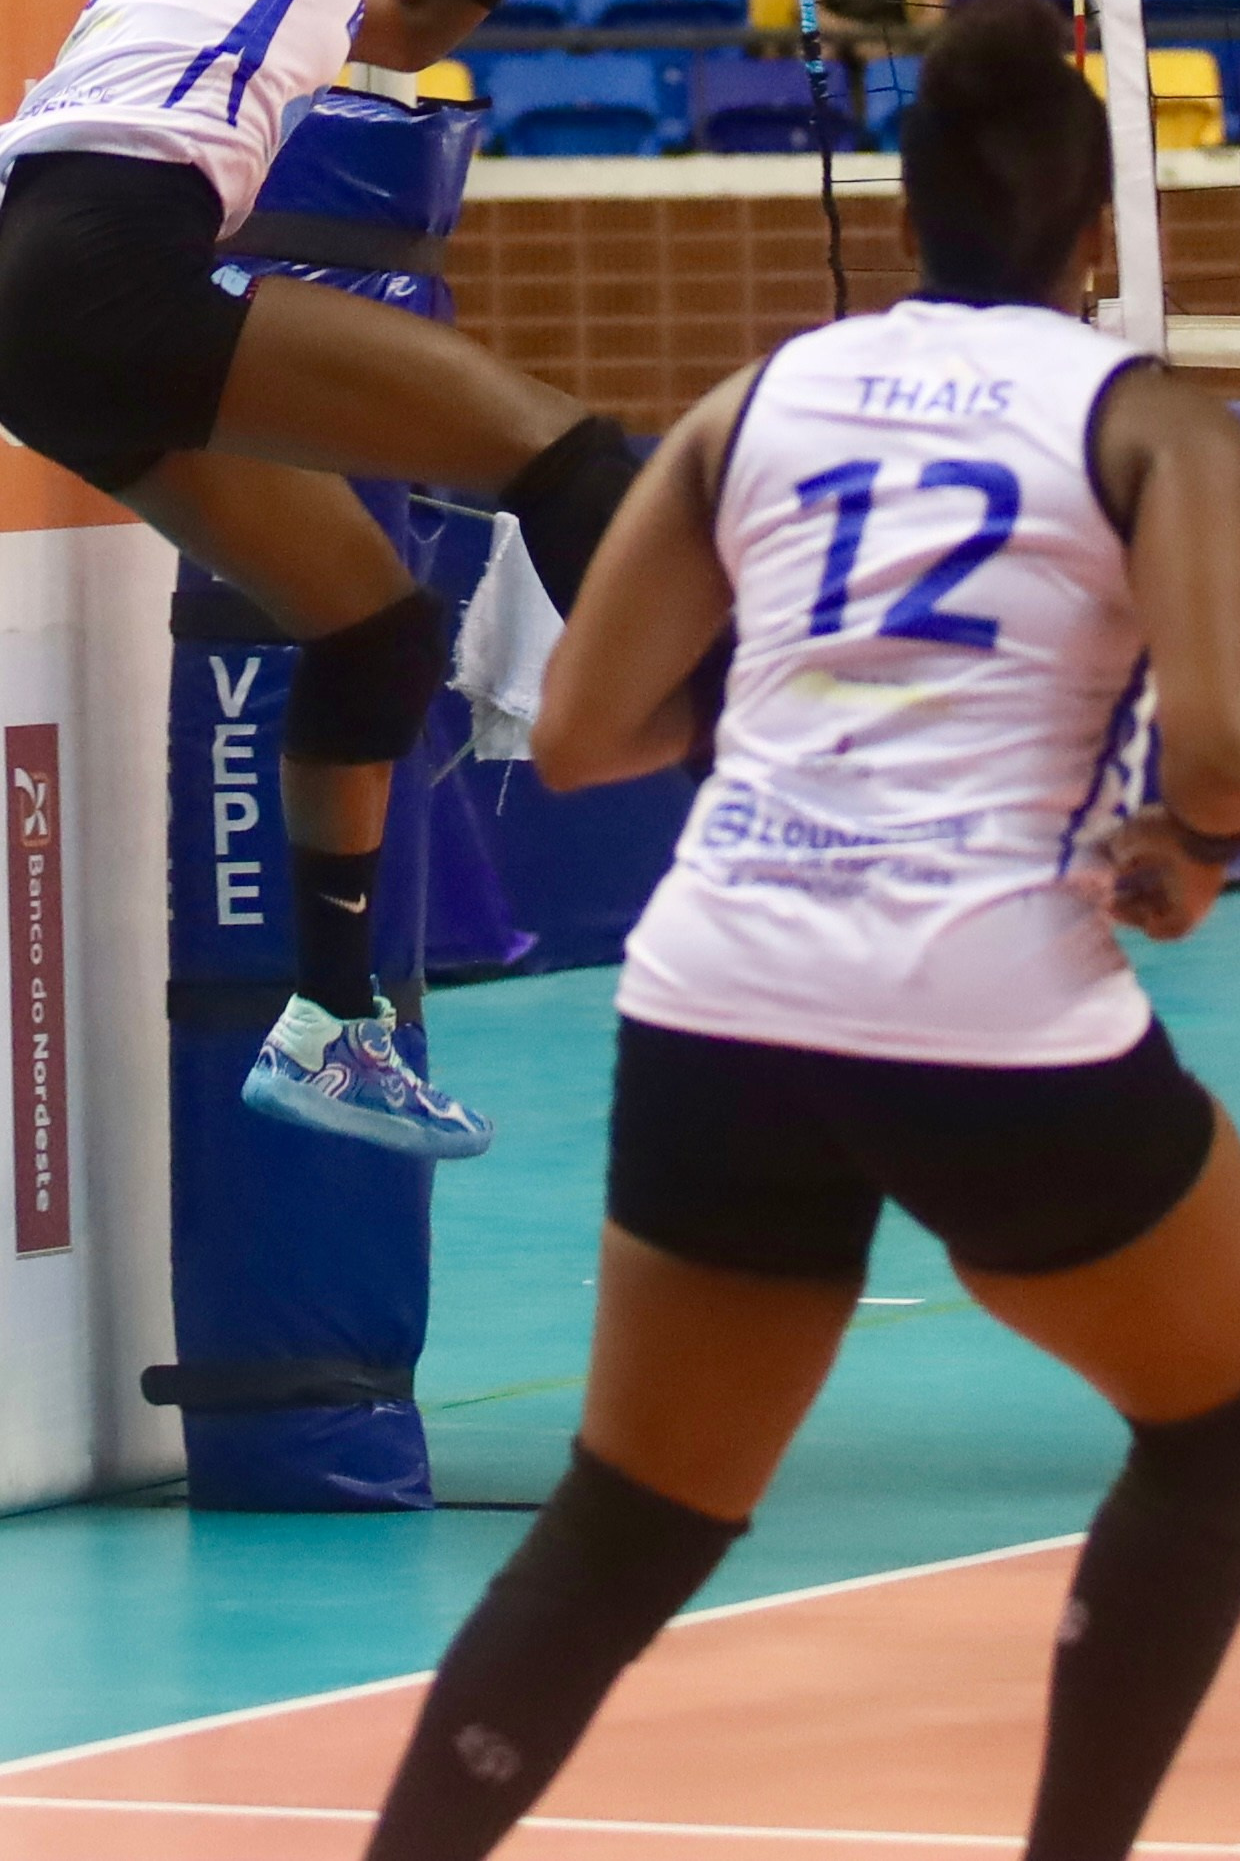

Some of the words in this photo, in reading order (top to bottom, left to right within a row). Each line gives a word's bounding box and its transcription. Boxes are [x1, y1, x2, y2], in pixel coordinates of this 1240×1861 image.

[855, 375, 1017, 420] THAIS
[794, 458, 1023, 650] 12
[27, 853, 45, 966] Banco
[31, 976, 48, 1024] do
[33, 1032, 51, 1213] Nordeste
